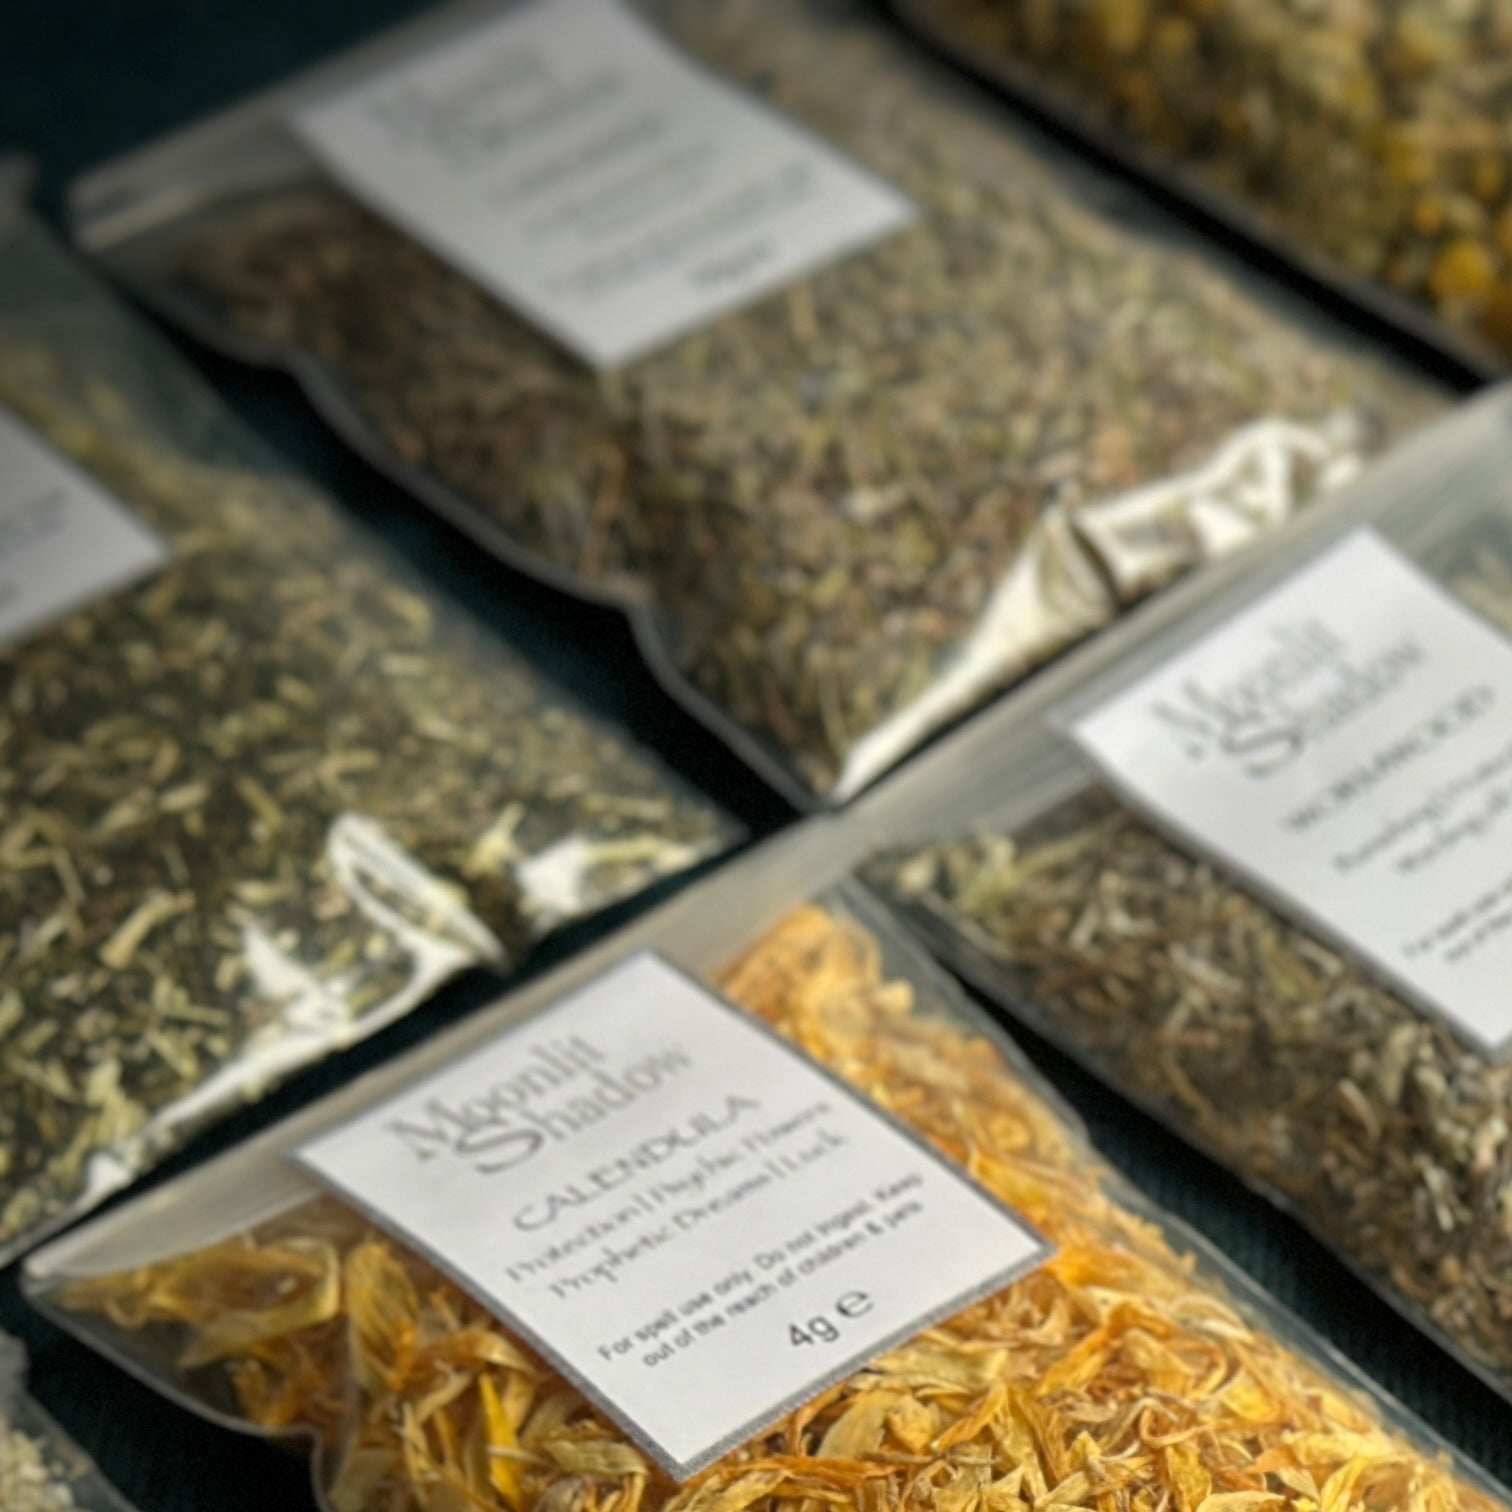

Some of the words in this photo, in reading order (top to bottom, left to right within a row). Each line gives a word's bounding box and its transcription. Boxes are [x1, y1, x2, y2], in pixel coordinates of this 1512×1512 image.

[381, 1036, 605, 1165] Moonlit
[449, 1053, 690, 1176] Shadow
[512, 1095, 760, 1233] CALENDULA
[597, 1336, 634, 1361] For
[633, 1309, 679, 1342] spell
[678, 1291, 714, 1317] use
[752, 1248, 787, 1271] Do
[784, 1230, 818, 1254] not
[642, 1341, 676, 1368] out
[673, 1327, 695, 1349] of
[691, 1313, 727, 1336] the
[725, 1283, 777, 1317] reach
[776, 1267, 798, 1288] of
[787, 1315, 841, 1347] 4g
